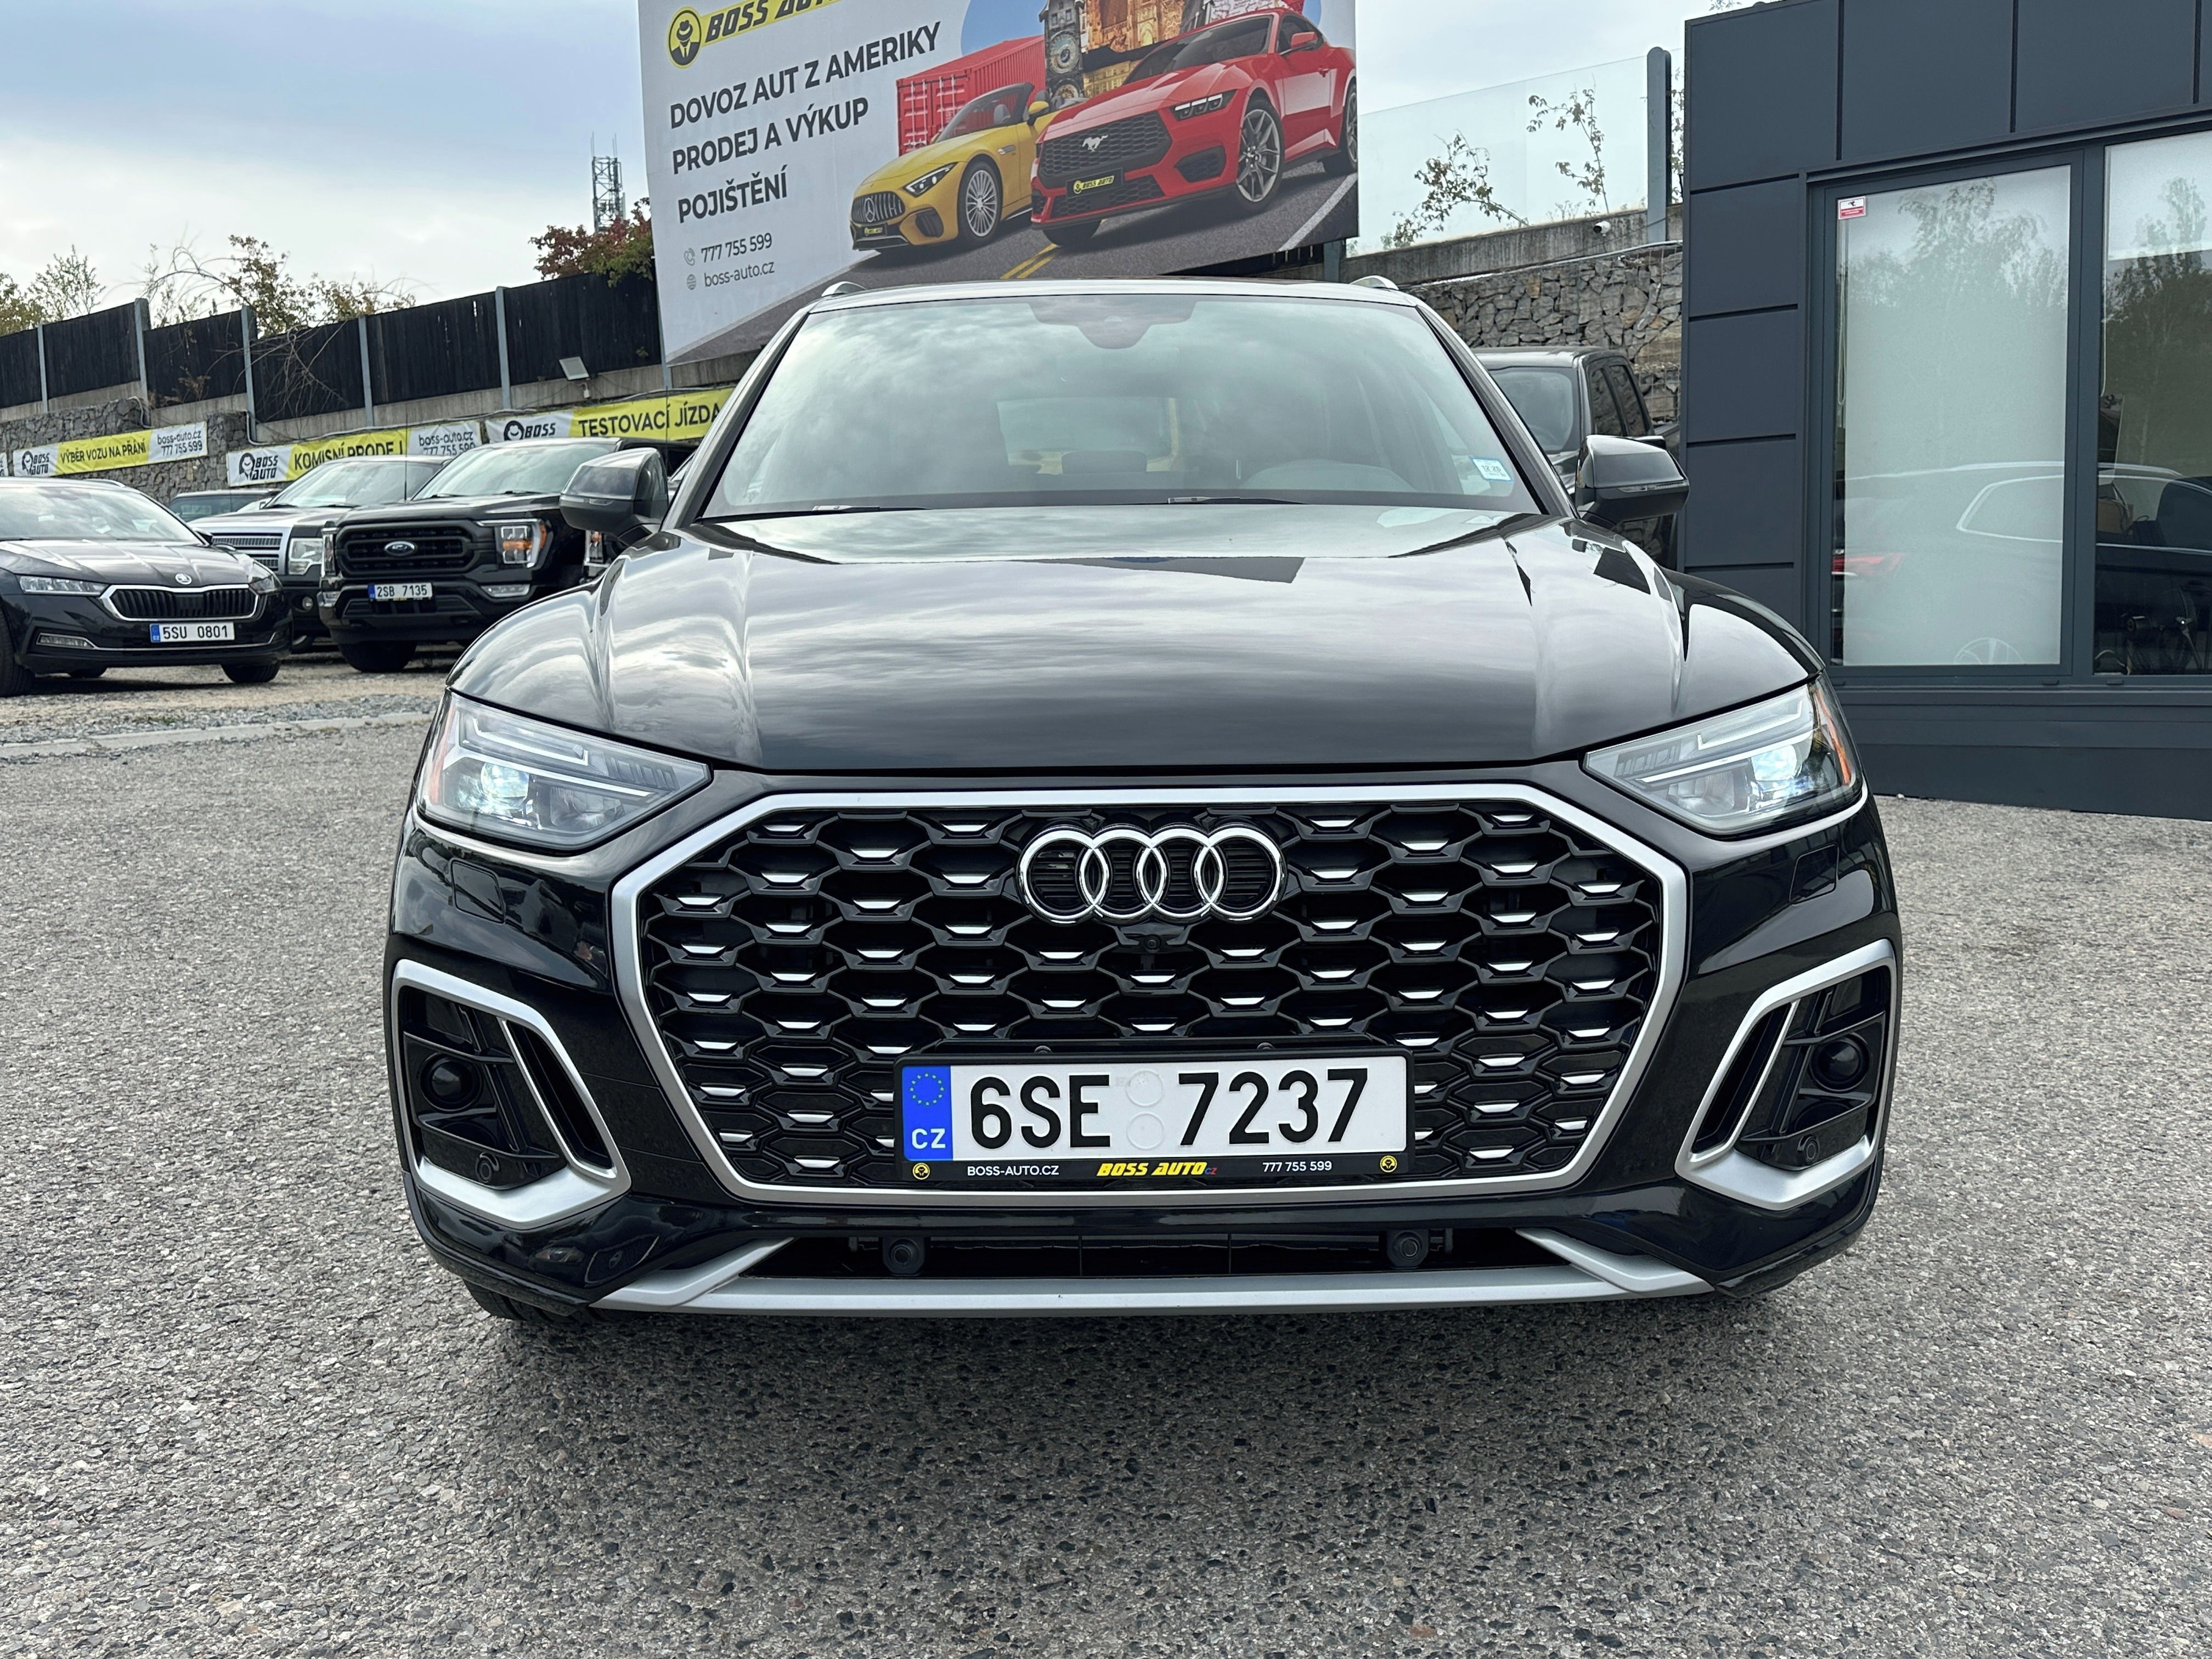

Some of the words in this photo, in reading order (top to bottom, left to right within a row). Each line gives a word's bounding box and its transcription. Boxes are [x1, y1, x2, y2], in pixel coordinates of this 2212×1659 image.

[705, 0, 768, 43] BOSS
[670, 82, 747, 129] DOVOZ
[753, 66, 799, 105] AUT
[805, 60, 820, 89] Z
[826, 21, 941, 83] AMERIKY
[673, 127, 758, 174] PRODEJ
[764, 122, 781, 150] A
[786, 97, 868, 142] VÝKUP
[678, 165, 788, 223] POJIŠTĚNÍ
[701, 244, 722, 263] 777
[725, 239, 747, 258] 755
[750, 233, 772, 252] 599
[704, 262, 775, 287] boss-auto.cz
[578, 403, 670, 437] TESTOVACÍ
[675, 402, 721, 427] JÍZDA
[157, 431, 201, 445] boss-auto.cz
[525, 423, 556, 438] BOSS
[419, 432, 473, 447] boss-auto.cz
[60, 447, 84, 464] VÝBĚR
[86, 447, 108, 460] VOZU
[109, 445, 122, 458] NA
[122, 438, 146, 456] PŘÁNÍ
[161, 445, 173, 456] 777
[175, 443, 187, 454] 755
[188, 440, 202, 452] 599
[441, 444, 457, 455] 755
[33, 453, 49, 465] BOSS
[255, 455, 279, 467] BOSS
[251, 467, 278, 480] AUTO
[377, 586, 395, 597] 2SB
[402, 585, 427, 597] 7135
[162, 626, 187, 640] 5SU
[198, 625, 228, 639] 0801
[970, 1074, 1110, 1149] 6SE
[1178, 1068, 1368, 1146] 7237
[911, 1128, 946, 1149] CZ
[967, 1165, 1059, 1176] BOSS-AUTO.CZ
[1096, 1162, 1149, 1177] BOSS
[1151, 1161, 1207, 1176] AUTO
[1262, 1161, 1283, 1172] 777
[1285, 1161, 1306, 1172] 755
[1310, 1160, 1332, 1171] 599
